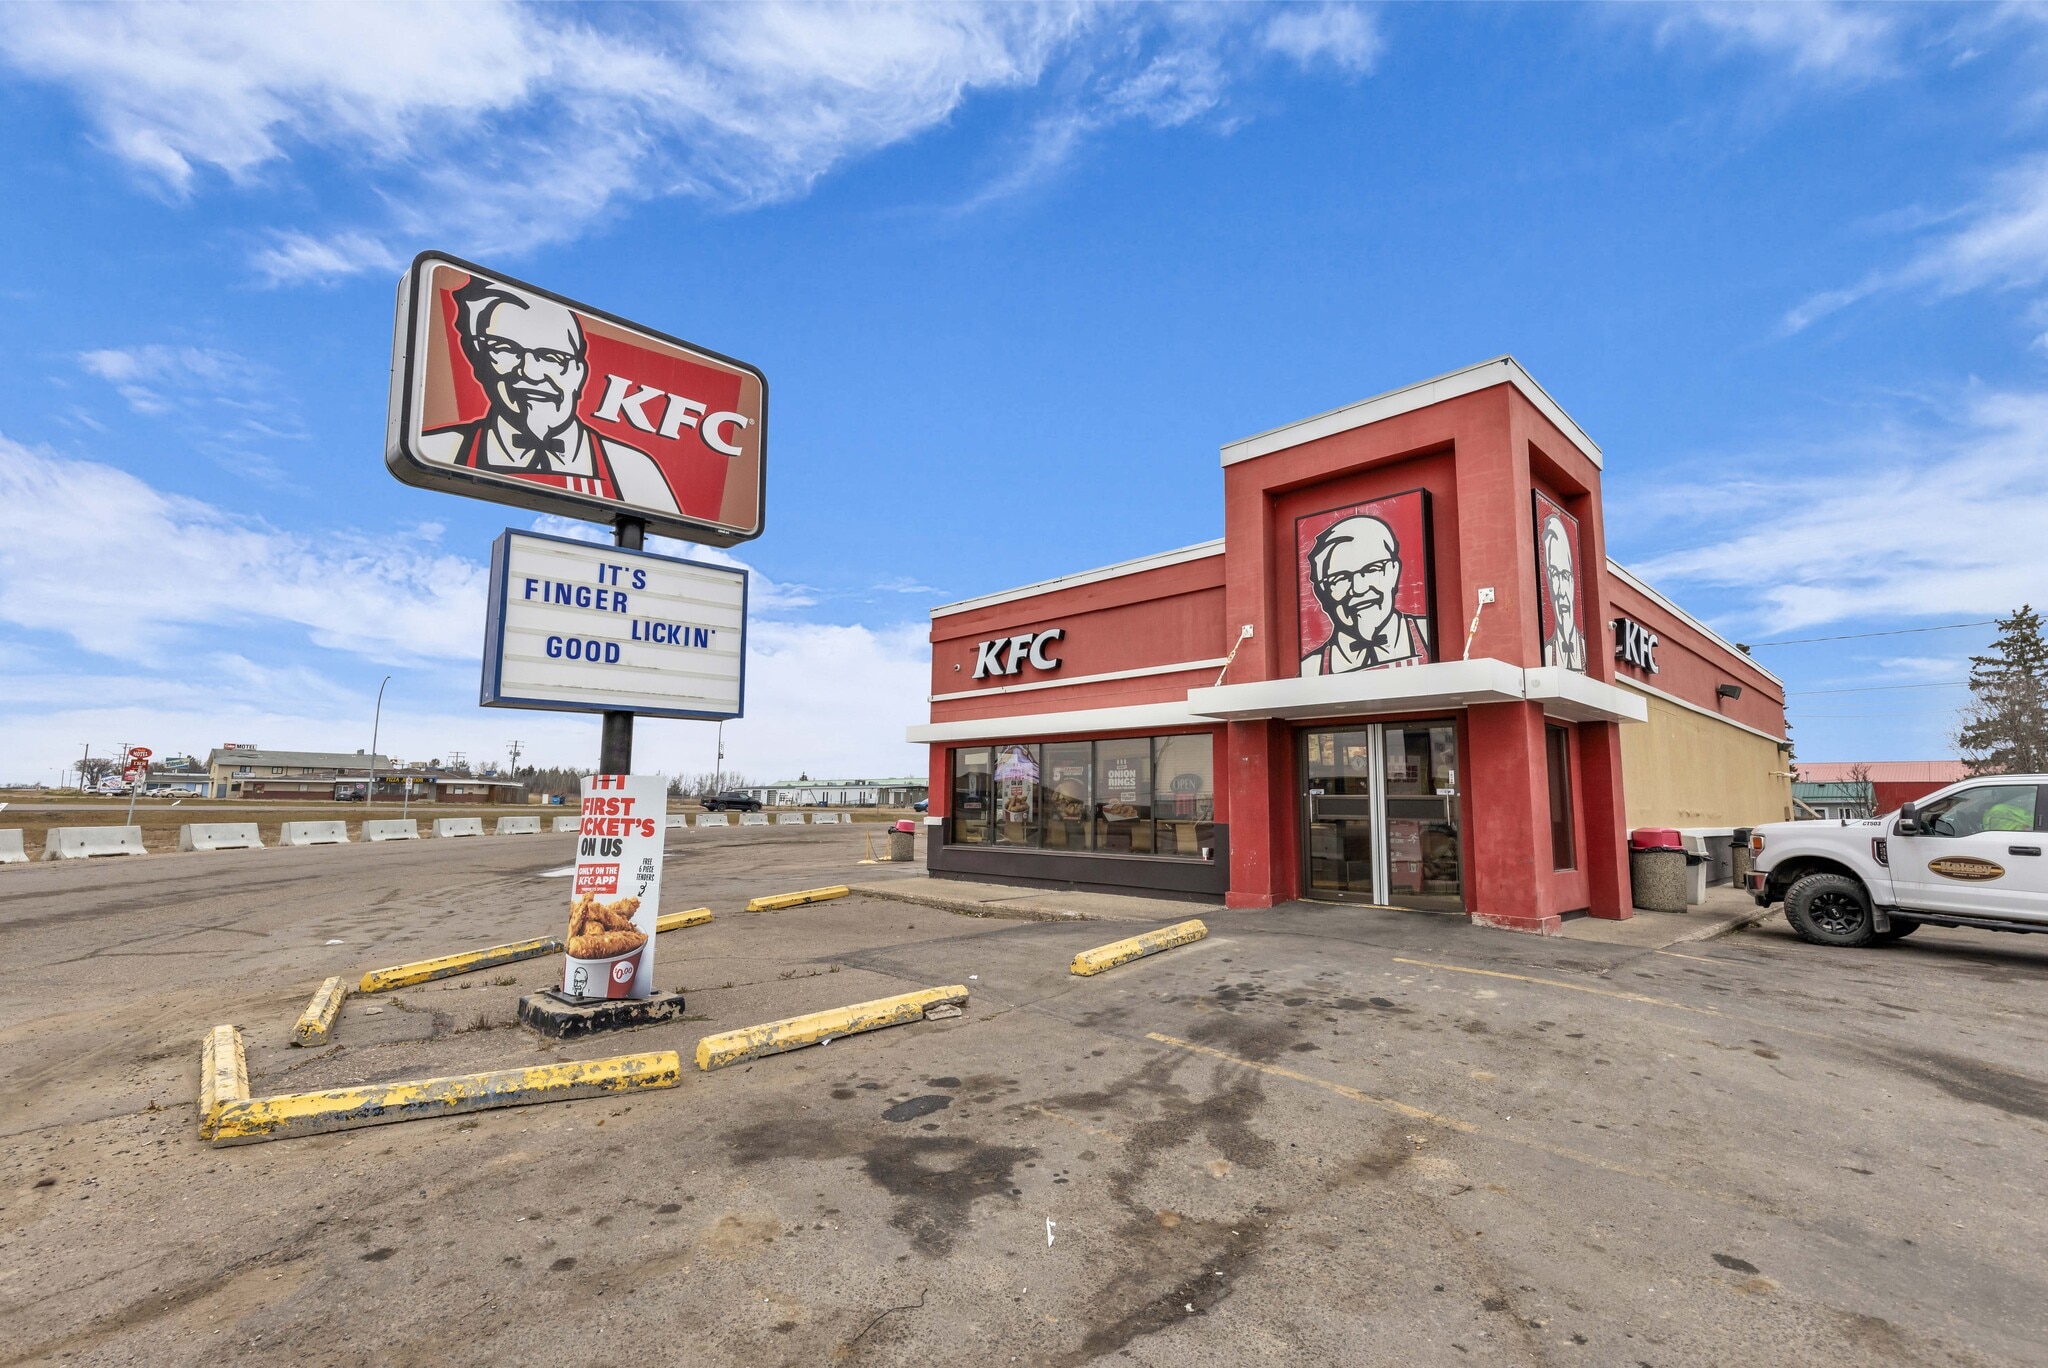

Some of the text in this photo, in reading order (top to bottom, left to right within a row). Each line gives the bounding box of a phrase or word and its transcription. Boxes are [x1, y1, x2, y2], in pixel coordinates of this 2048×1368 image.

[592, 373, 748, 456] KFC
[598, 563, 647, 590] IT'S
[524, 578, 628, 614] FINGER
[631, 619, 716, 649] LICKIN'
[546, 636, 621, 664] GOOD
[971, 629, 1064, 679] KFC
[1625, 618, 1659, 674] KFC
[1108, 769, 1136, 778] ONION
[1108, 778, 1136, 786] RINGS
[1172, 779, 1196, 790] OPEN
[582, 797, 636, 816] FIRST
[581, 837, 623, 857] ON US
[579, 866, 618, 875] ONLY ON THE
[642, 857, 653, 865] FREE
[578, 876, 616, 885] KFC APP
[636, 873, 655, 881] TENDERS
